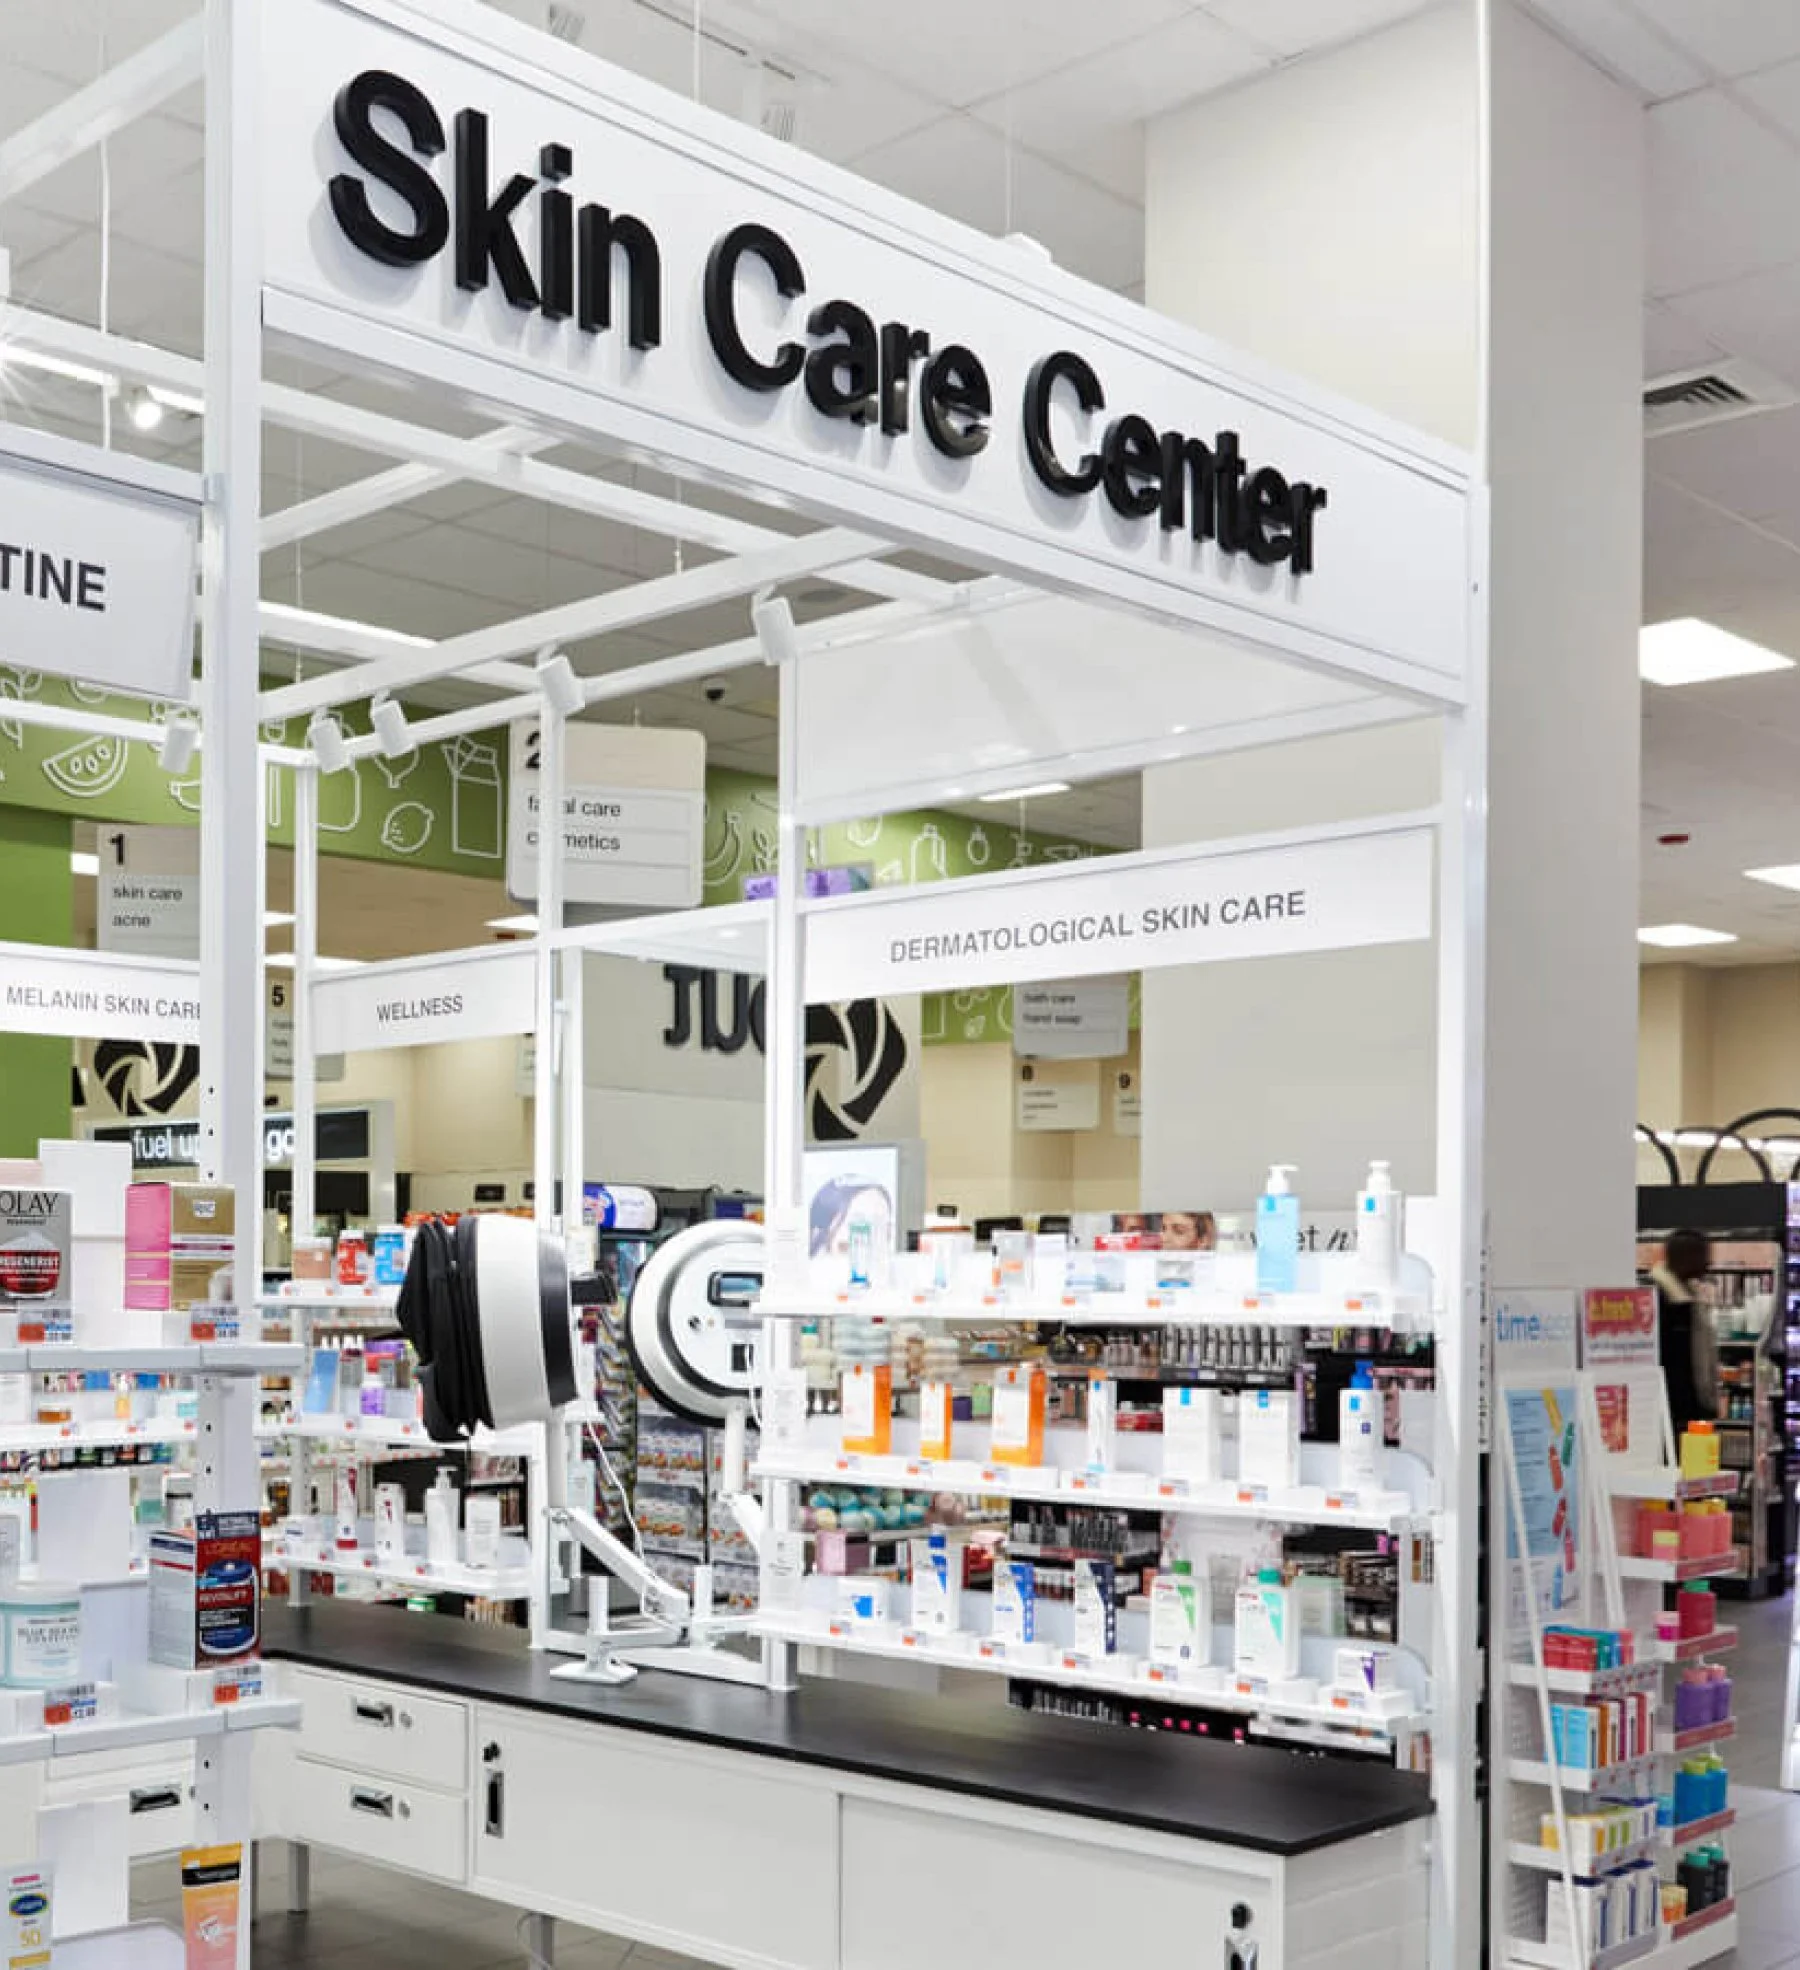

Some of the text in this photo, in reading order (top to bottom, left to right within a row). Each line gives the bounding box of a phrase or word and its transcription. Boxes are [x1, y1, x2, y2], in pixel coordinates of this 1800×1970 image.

[330, 69, 1327, 576] Skin Care Center
[582, 803, 621, 818] care
[108, 833, 126, 866] 1
[112, 885, 183, 901] skin care
[112, 914, 151, 928] acne
[890, 890, 1307, 963] DERMATOLOGICAL SKIN CARE
[6, 985, 98, 1011] MELANIN
[104, 994, 150, 1016] SKIN
[271, 984, 285, 1008] 5
[376, 993, 463, 1022] WELLNESS
[133, 1127, 172, 1159] fuel
[0, 1190, 59, 1215] OLAY
